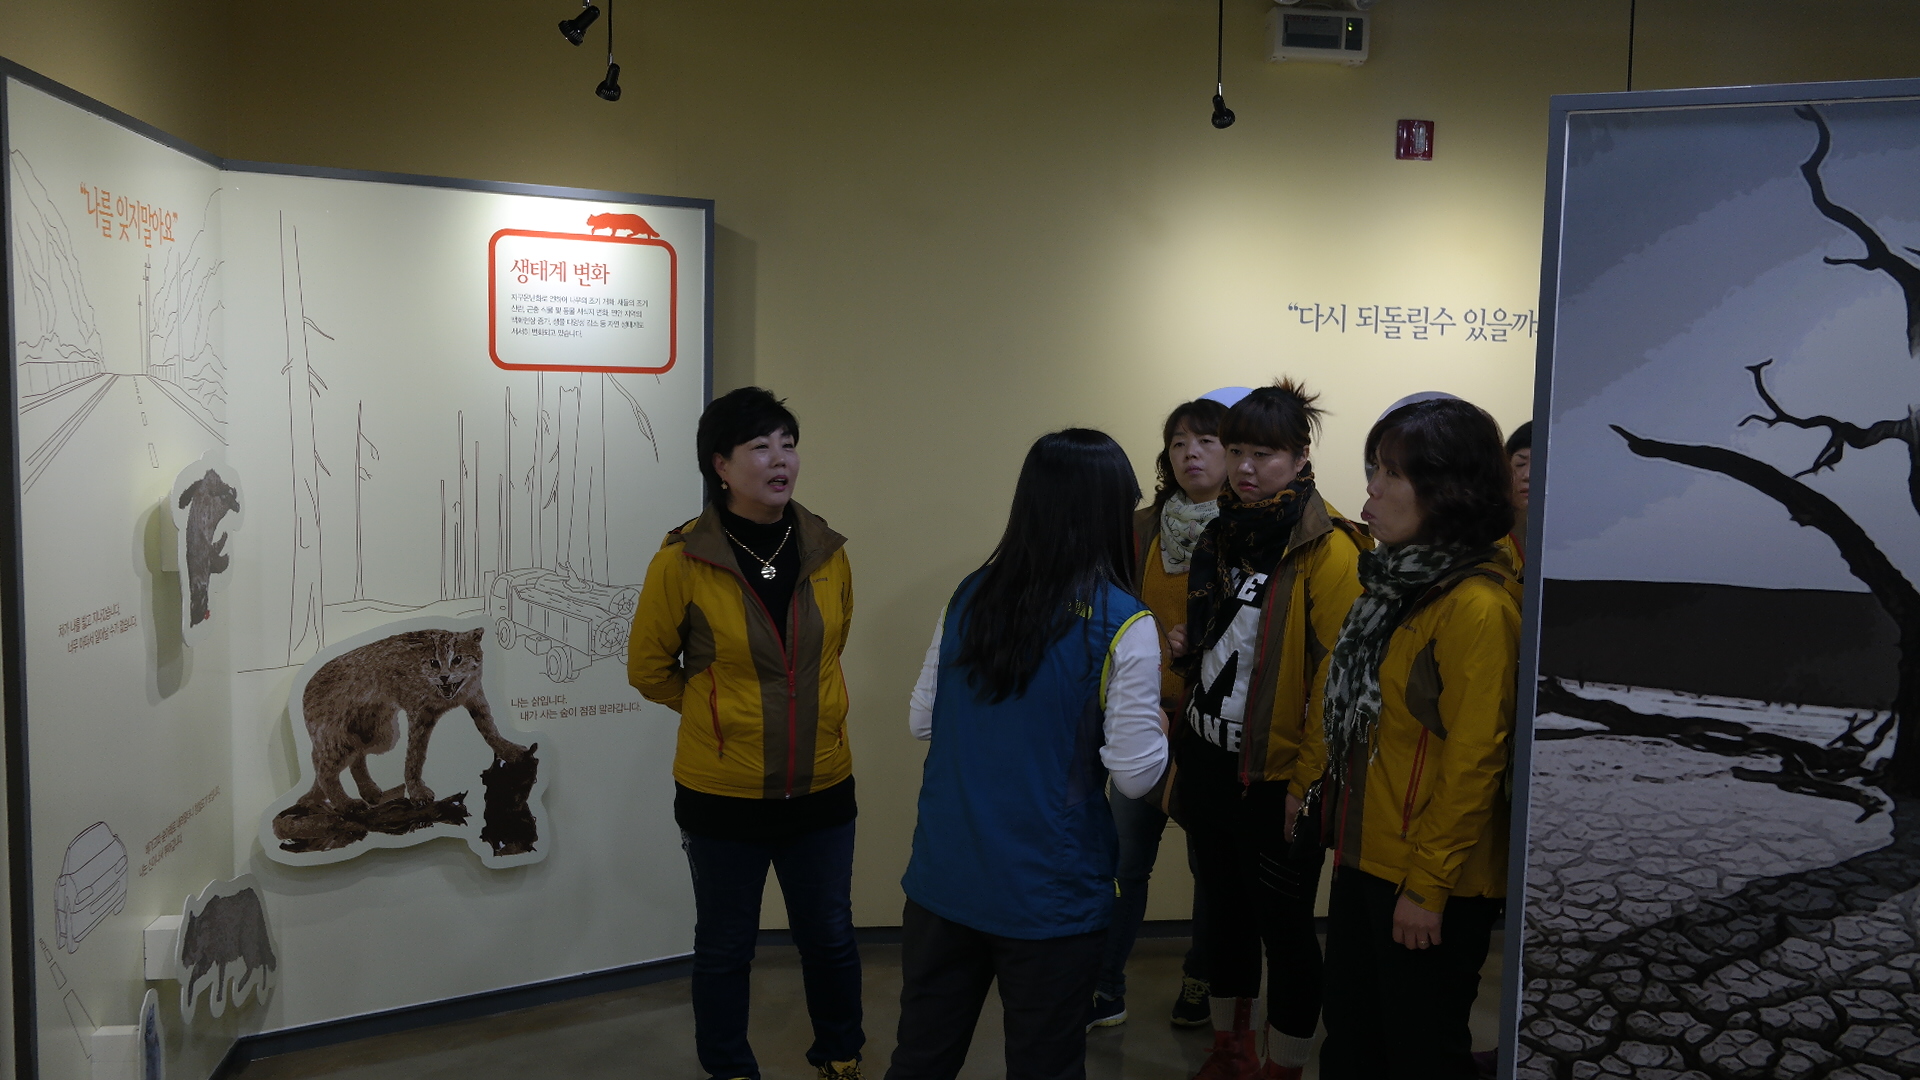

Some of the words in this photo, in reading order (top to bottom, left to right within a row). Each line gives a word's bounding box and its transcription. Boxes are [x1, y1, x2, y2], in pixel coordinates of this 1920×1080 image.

[510, 258, 567, 284] 생태계
[573, 262, 611, 287] 변화
[1287, 302, 1347, 334] “다시
[1355, 305, 1457, 341] 되돌릴수
[1463, 308, 1539, 343] 있을까
[511, 697, 529, 709] 나는
[520, 711, 538, 721] 내가
[539, 709, 558, 720] 사는
[559, 706, 577, 718] 숲이
[579, 704, 597, 717] 점점
